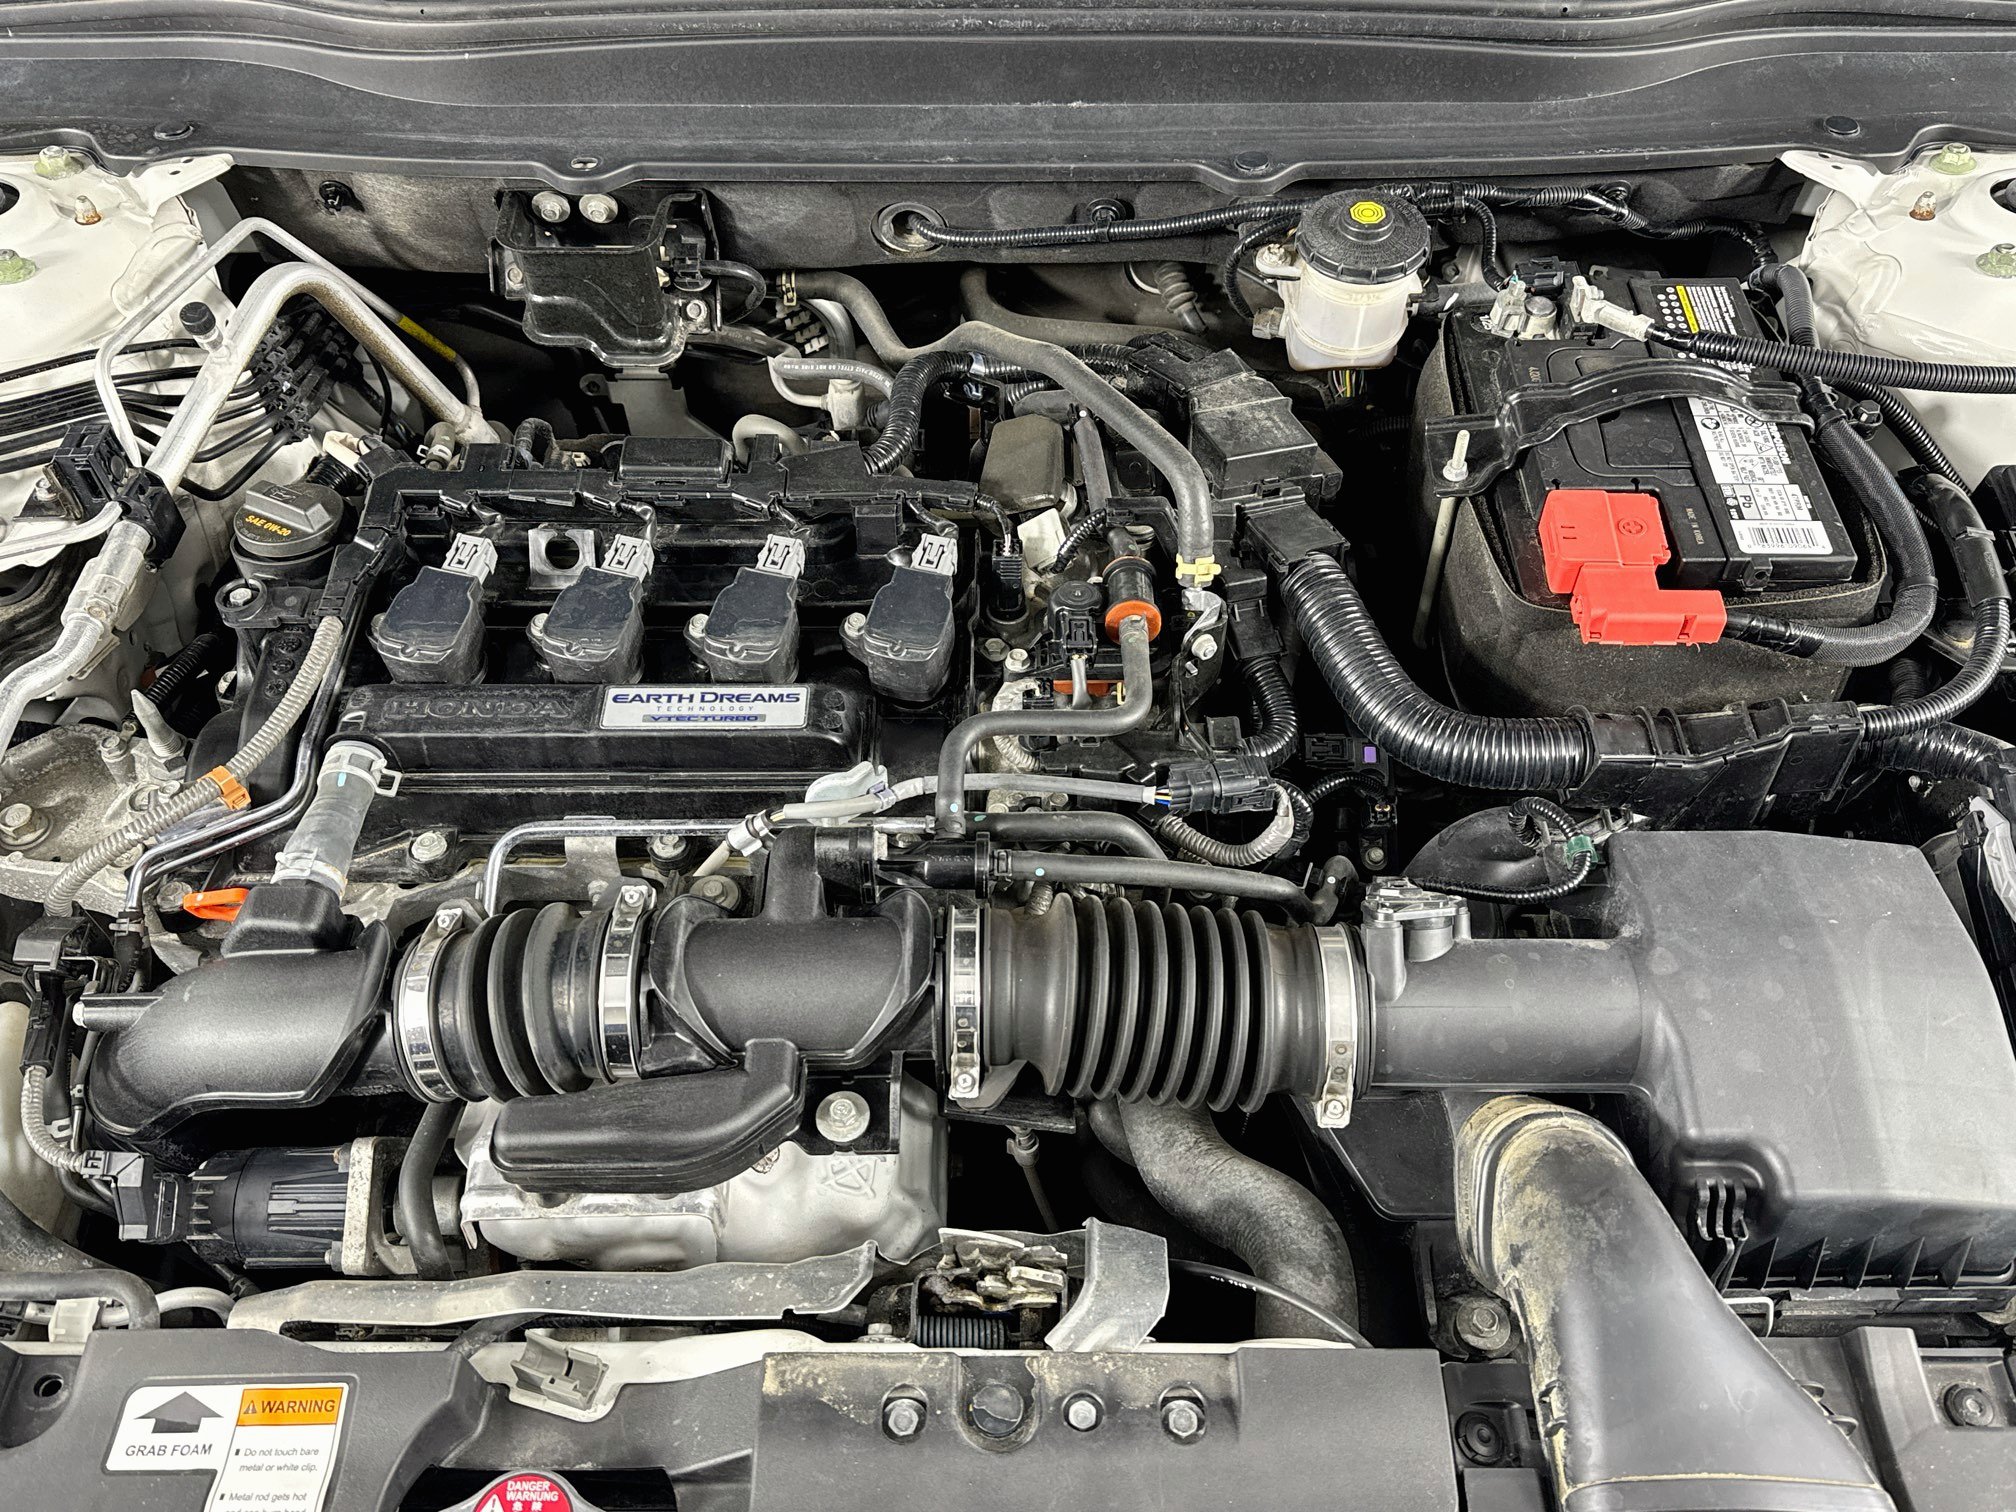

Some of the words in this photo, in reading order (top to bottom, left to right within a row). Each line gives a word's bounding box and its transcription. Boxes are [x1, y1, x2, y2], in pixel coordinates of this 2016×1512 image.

[1739, 495, 1754, 508] Pb
[245, 515, 267, 527] SAE
[263, 522, 292, 536] 0W-20
[612, 693, 694, 704] EARTH
[700, 692, 800, 703] DREAMS
[383, 699, 572, 718] HONDA
[261, 1399, 336, 1414] WARNING
[125, 1444, 168, 1457] GRAB
[171, 1443, 213, 1456] FOAM
[244, 1448, 257, 1456] Do
[259, 1448, 273, 1456] not
[274, 1448, 298, 1456] touch
[300, 1447, 319, 1456] bare
[239, 1463, 264, 1471] metal
[277, 1463, 299, 1471] white
[301, 1463, 318, 1473] clip.
[507, 1481, 550, 1491] DANGER
[229, 1493, 253, 1501] Metal
[255, 1493, 270, 1501] rod
[271, 1493, 290, 1503] gets
[292, 1493, 307, 1501] hot
[506, 1492, 558, 1501] WARNUNG
